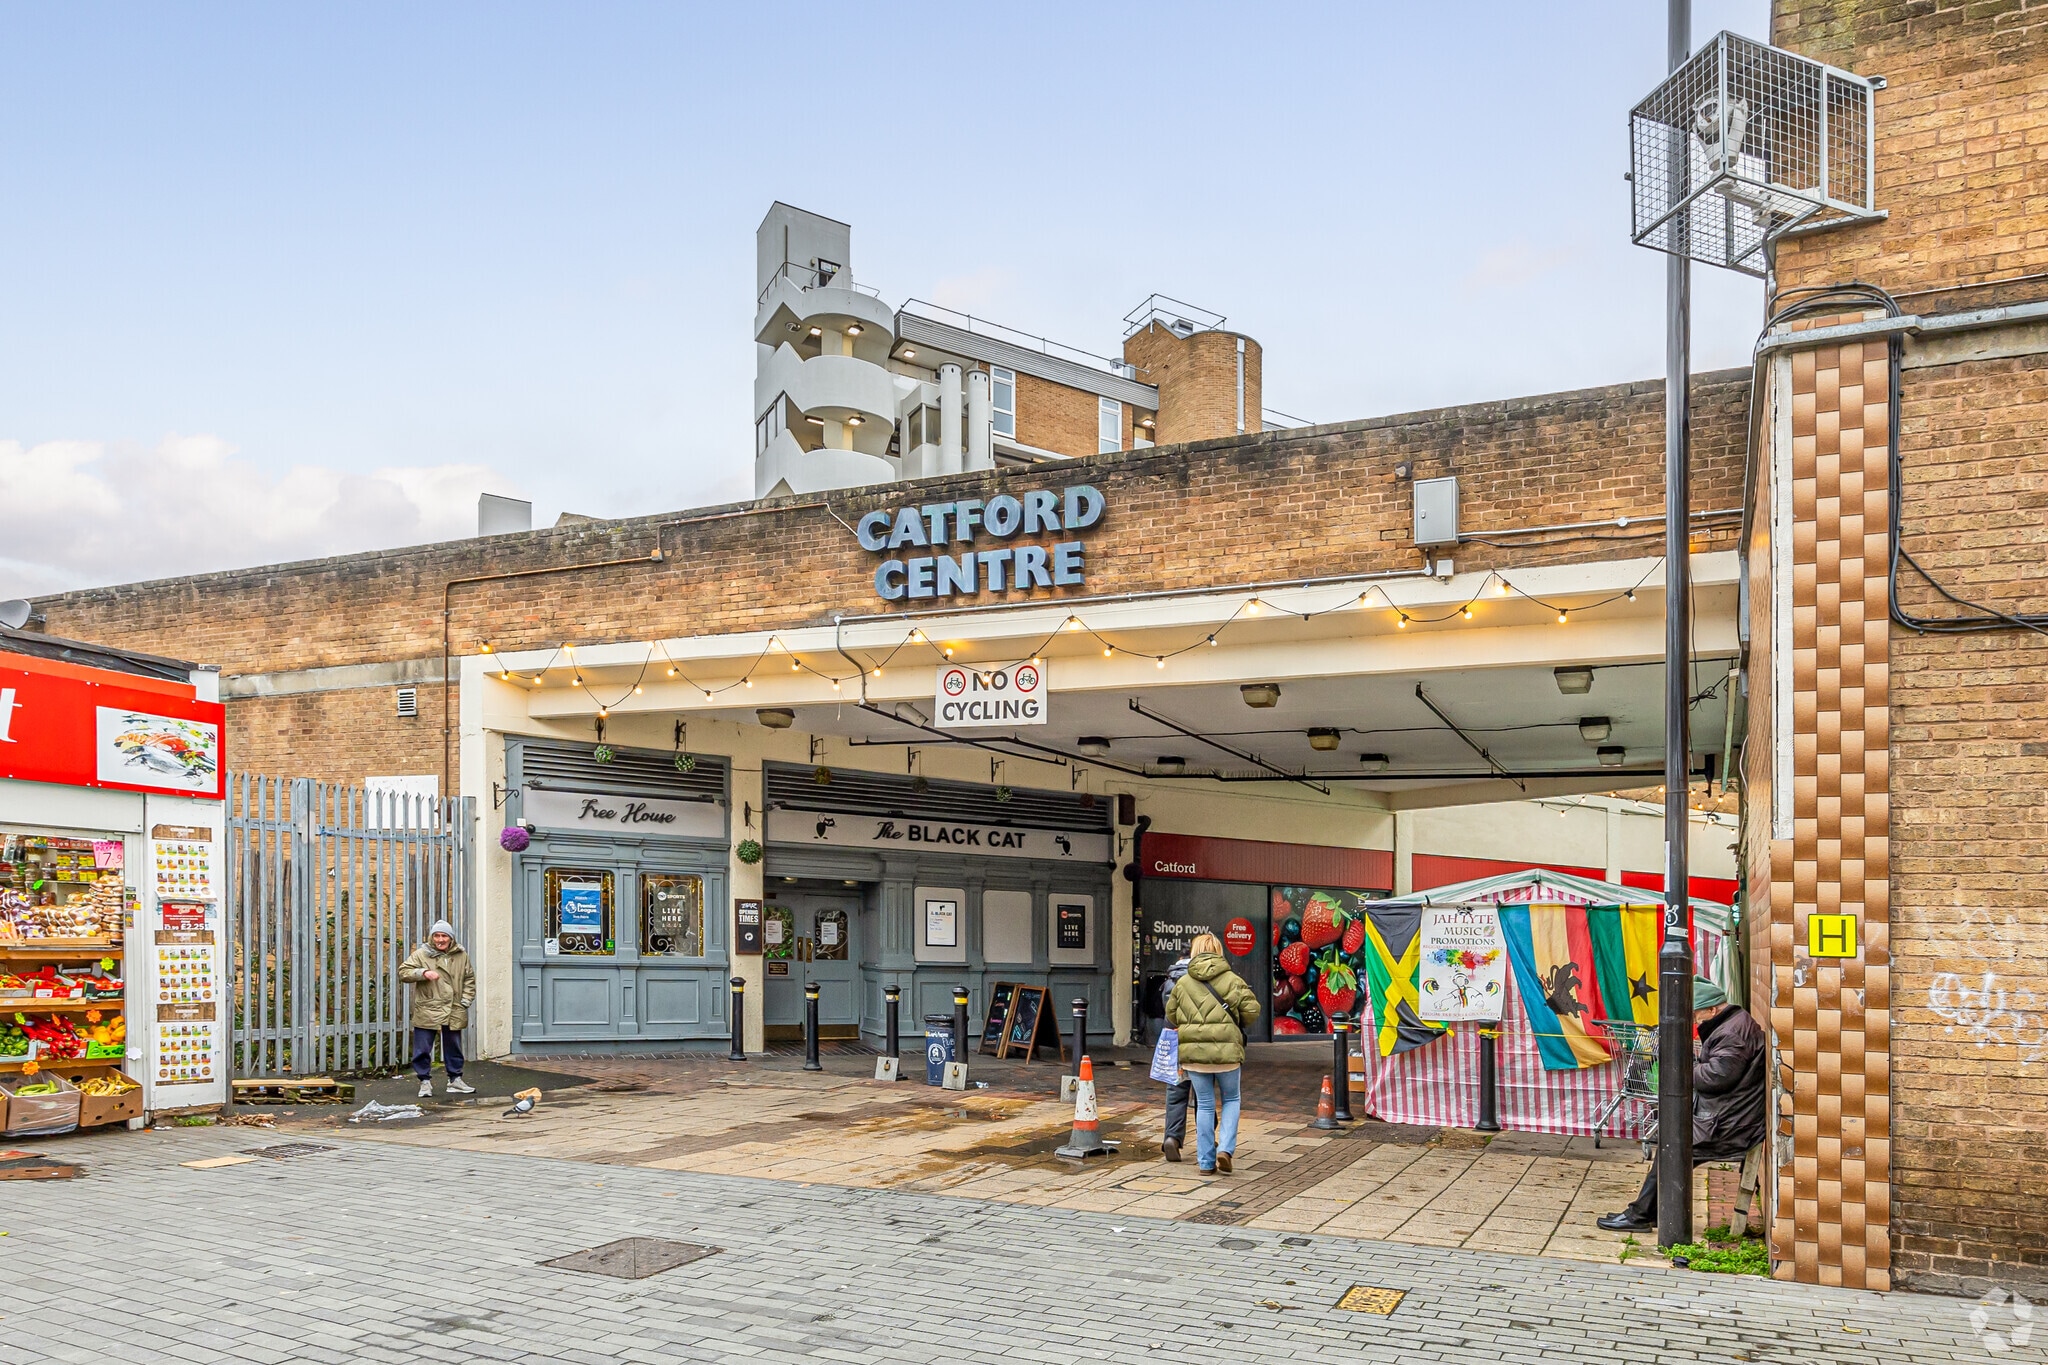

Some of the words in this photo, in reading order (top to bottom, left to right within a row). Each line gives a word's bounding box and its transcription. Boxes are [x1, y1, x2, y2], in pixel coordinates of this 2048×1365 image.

[857, 485, 1106, 551] CATFORD
[874, 541, 1086, 600] CENTRE
[972, 670, 1008, 691] NO
[942, 699, 1040, 721] CYCLING
[578, 798, 618, 819] Free
[620, 802, 677, 823] House
[872, 821, 904, 840] The
[908, 824, 981, 846] BLACK
[987, 831, 1026, 849] CAT
[1154, 860, 1196, 874] Catford
[739, 915, 759, 923] TIMES
[1434, 914, 1458, 926] JAH
[1461, 914, 1494, 924] LYTE
[1153, 920, 1183, 936] Shop
[1232, 923, 1247, 931] Free
[1444, 926, 1482, 936] MUSIC
[1226, 931, 1252, 940] delivery
[1431, 937, 1496, 946] PROMOTIONS
[1818, 919, 1847, 952] H
[1155, 938, 1181, 951] We'll
